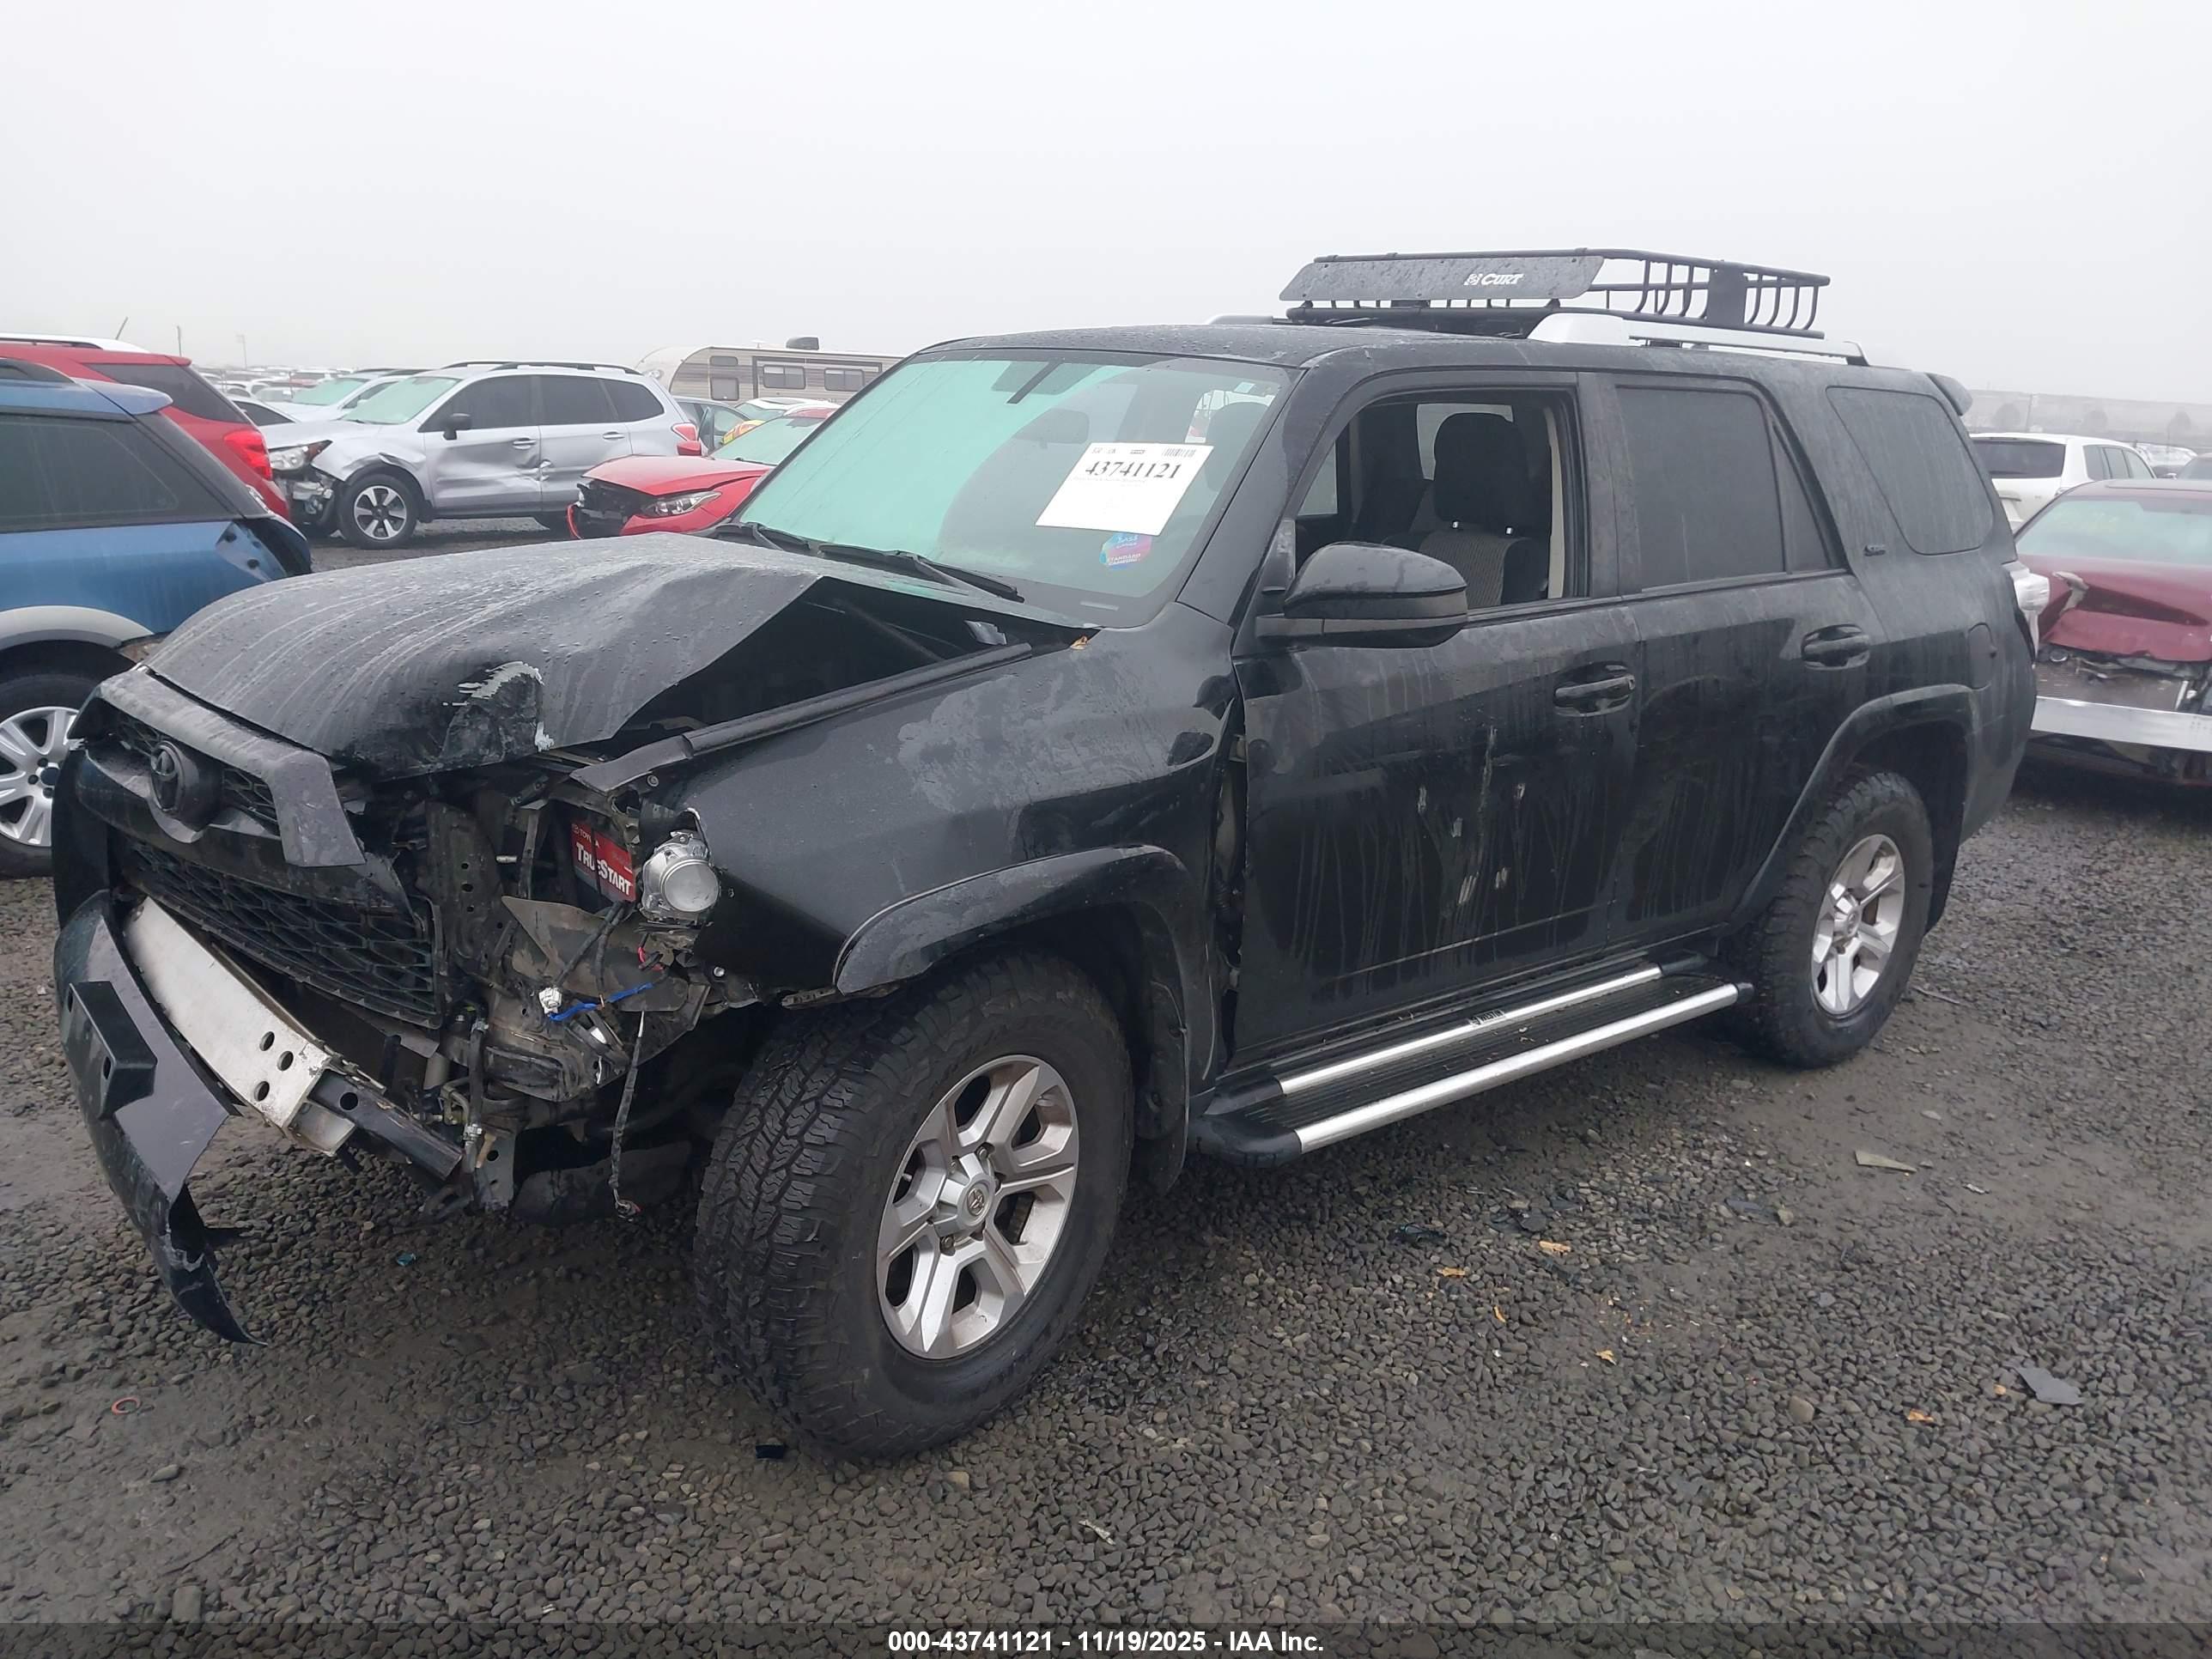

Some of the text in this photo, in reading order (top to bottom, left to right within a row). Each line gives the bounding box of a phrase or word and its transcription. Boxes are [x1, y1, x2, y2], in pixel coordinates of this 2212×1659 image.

[1481, 273, 1524, 285] CURT
[1085, 460, 1182, 479] 43741121
[580, 828, 600, 848] TOYA
